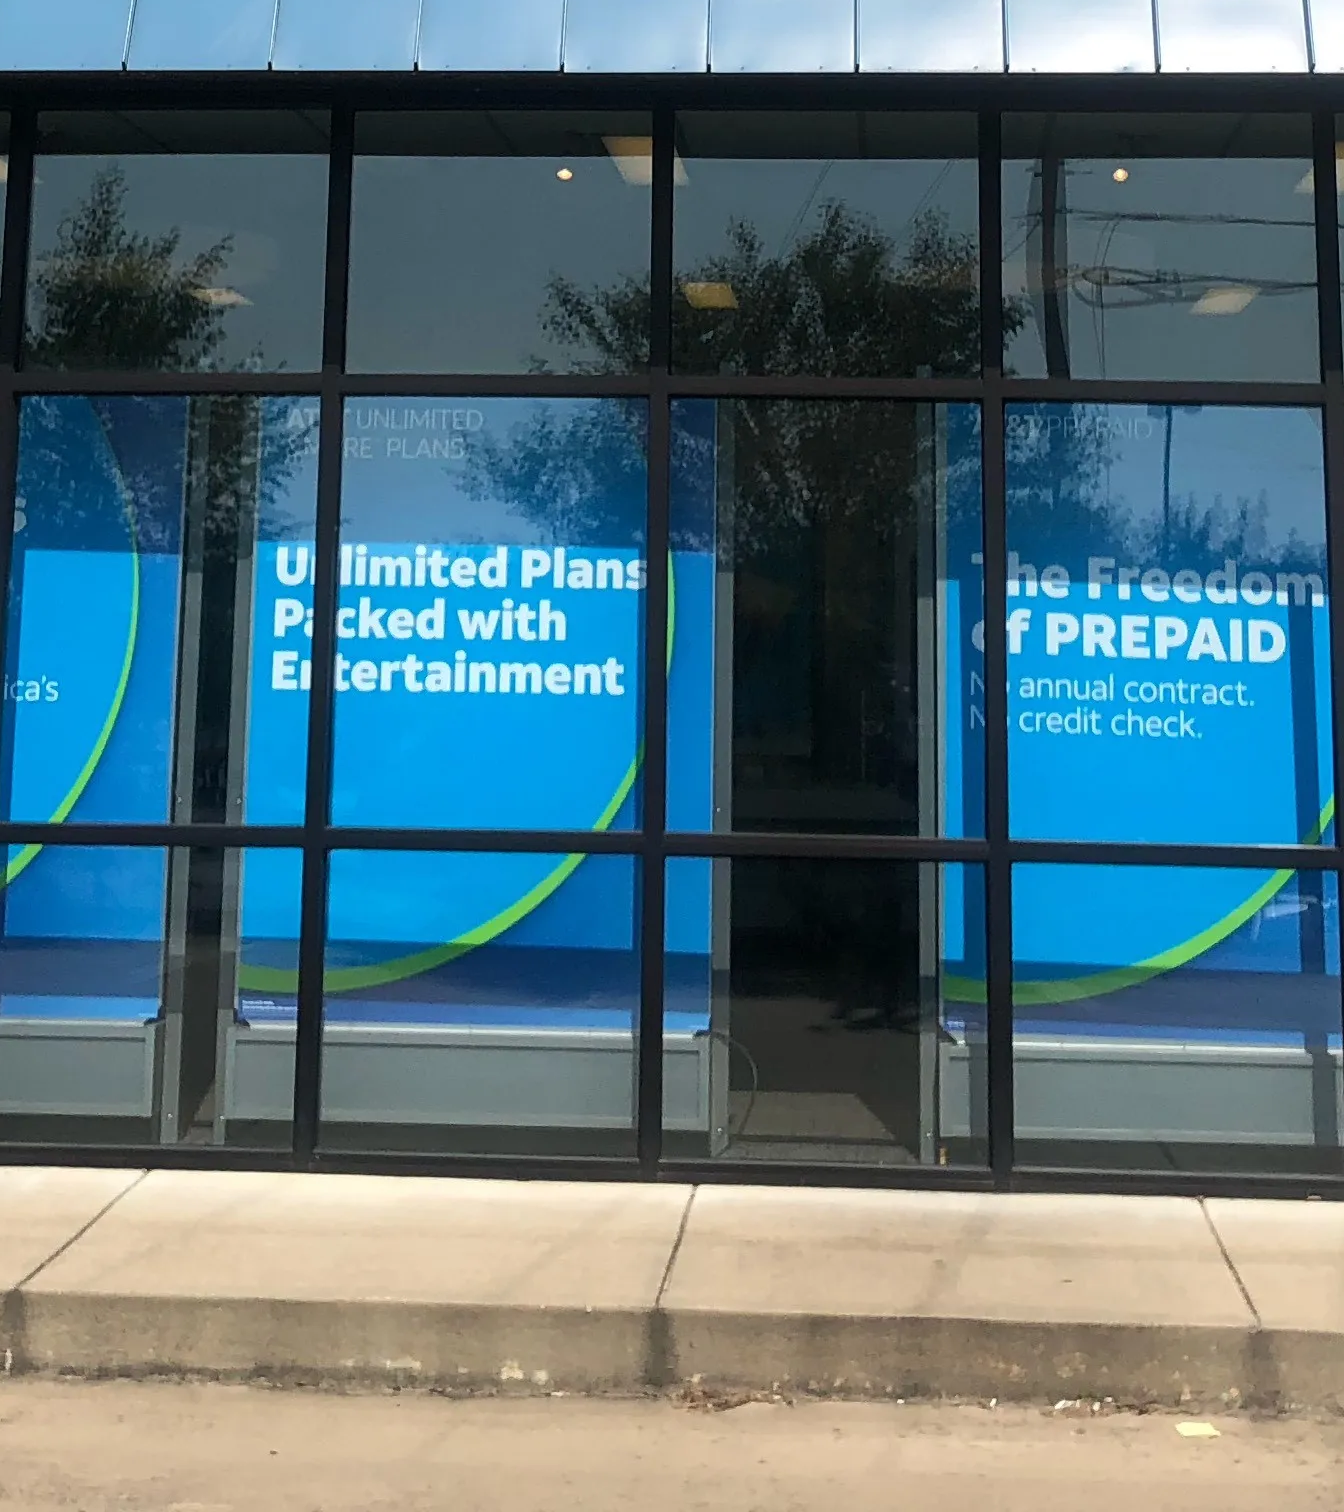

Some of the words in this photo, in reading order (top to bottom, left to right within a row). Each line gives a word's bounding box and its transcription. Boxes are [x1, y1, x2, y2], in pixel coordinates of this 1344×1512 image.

[356, 409, 483, 431] UNLIMITED
[387, 438, 464, 460] PLANS
[275, 545, 507, 588] Ulimited
[520, 548, 647, 591] Plans
[971, 552, 1071, 600] he
[1087, 557, 1326, 608] Freedom
[457, 599, 567, 641] with
[1046, 614, 1287, 663] PREPAID
[1019, 674, 1115, 701] annual
[1123, 678, 1255, 708] contract.
[1019, 706, 1103, 735] credit
[1111, 708, 1203, 739] check.
